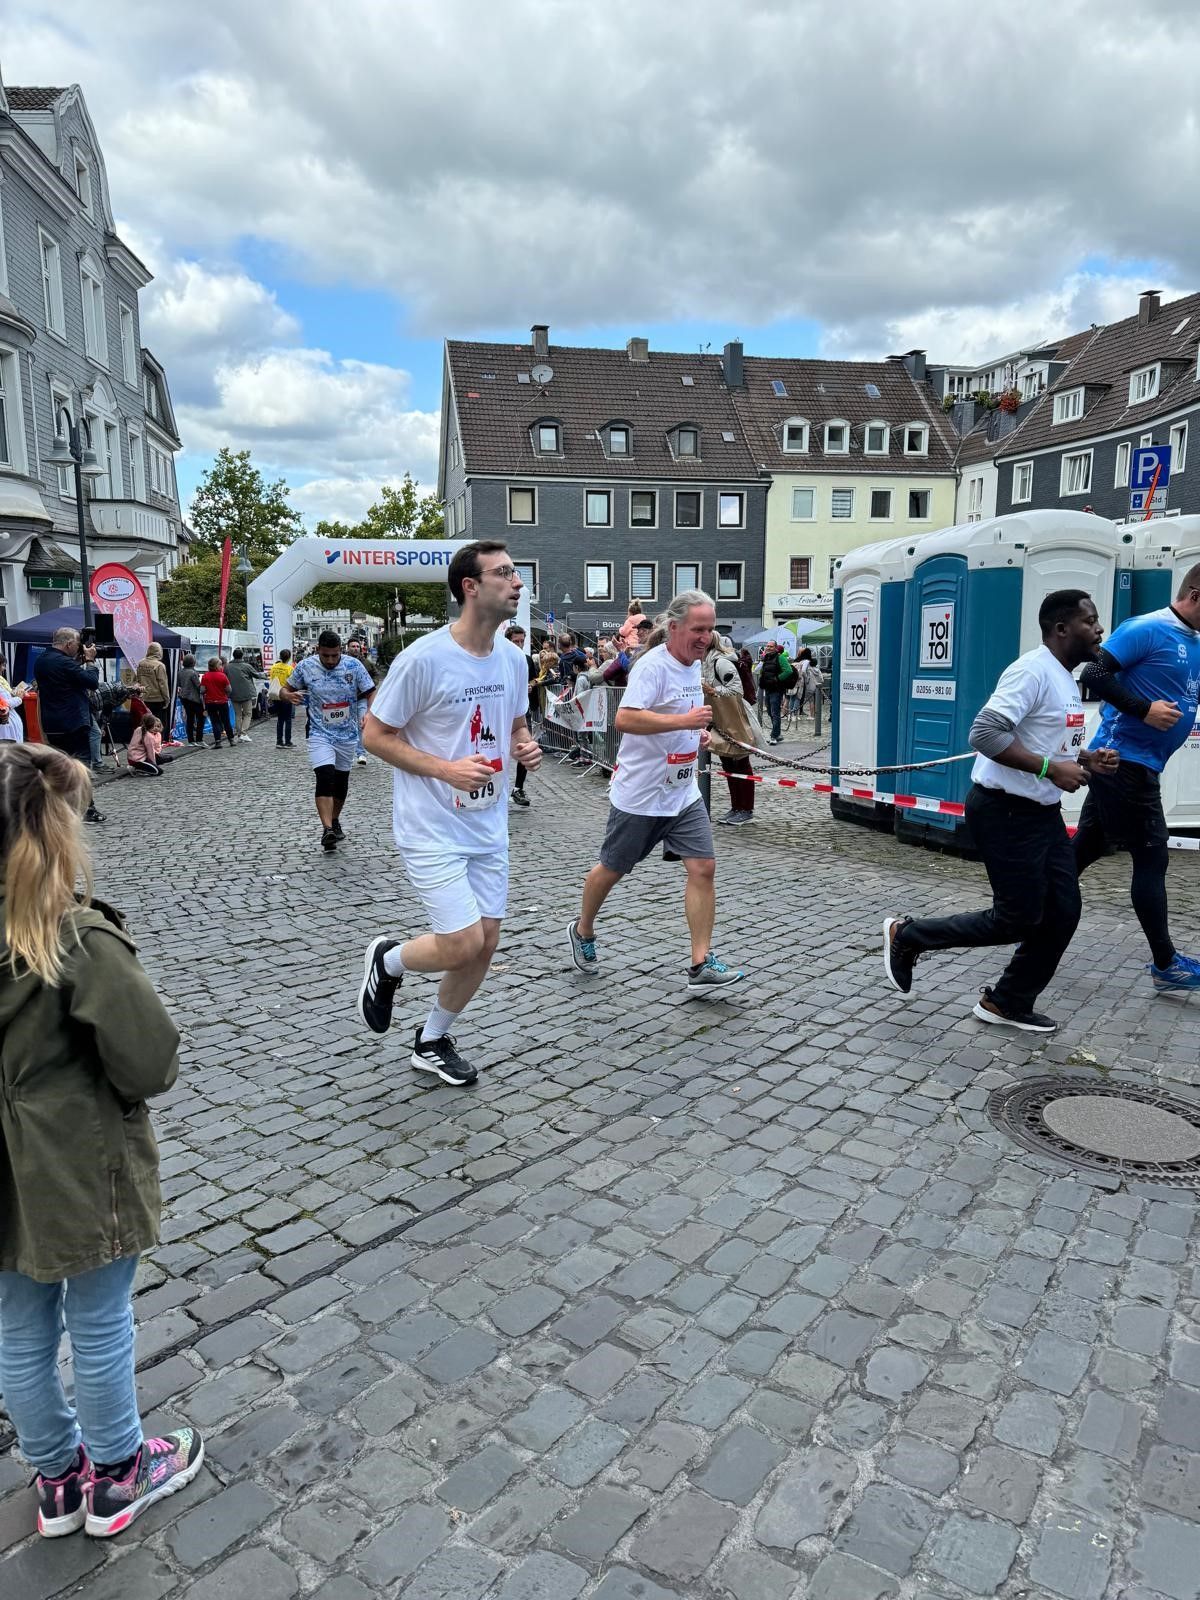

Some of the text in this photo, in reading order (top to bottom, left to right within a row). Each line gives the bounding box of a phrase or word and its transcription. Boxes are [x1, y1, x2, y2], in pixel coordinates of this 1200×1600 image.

[1137, 452, 1159, 484] P
[343, 550, 452, 566] INTERSPORT
[262, 603, 274, 673] TERSPORT
[851, 624, 866, 640] TOI
[929, 621, 949, 640] TOI
[850, 641, 866, 657] TOI
[928, 641, 948, 660] TOI
[464, 684, 505, 697] FRISCHKORN
[330, 711, 344, 719] 699
[677, 767, 693, 780] 681
